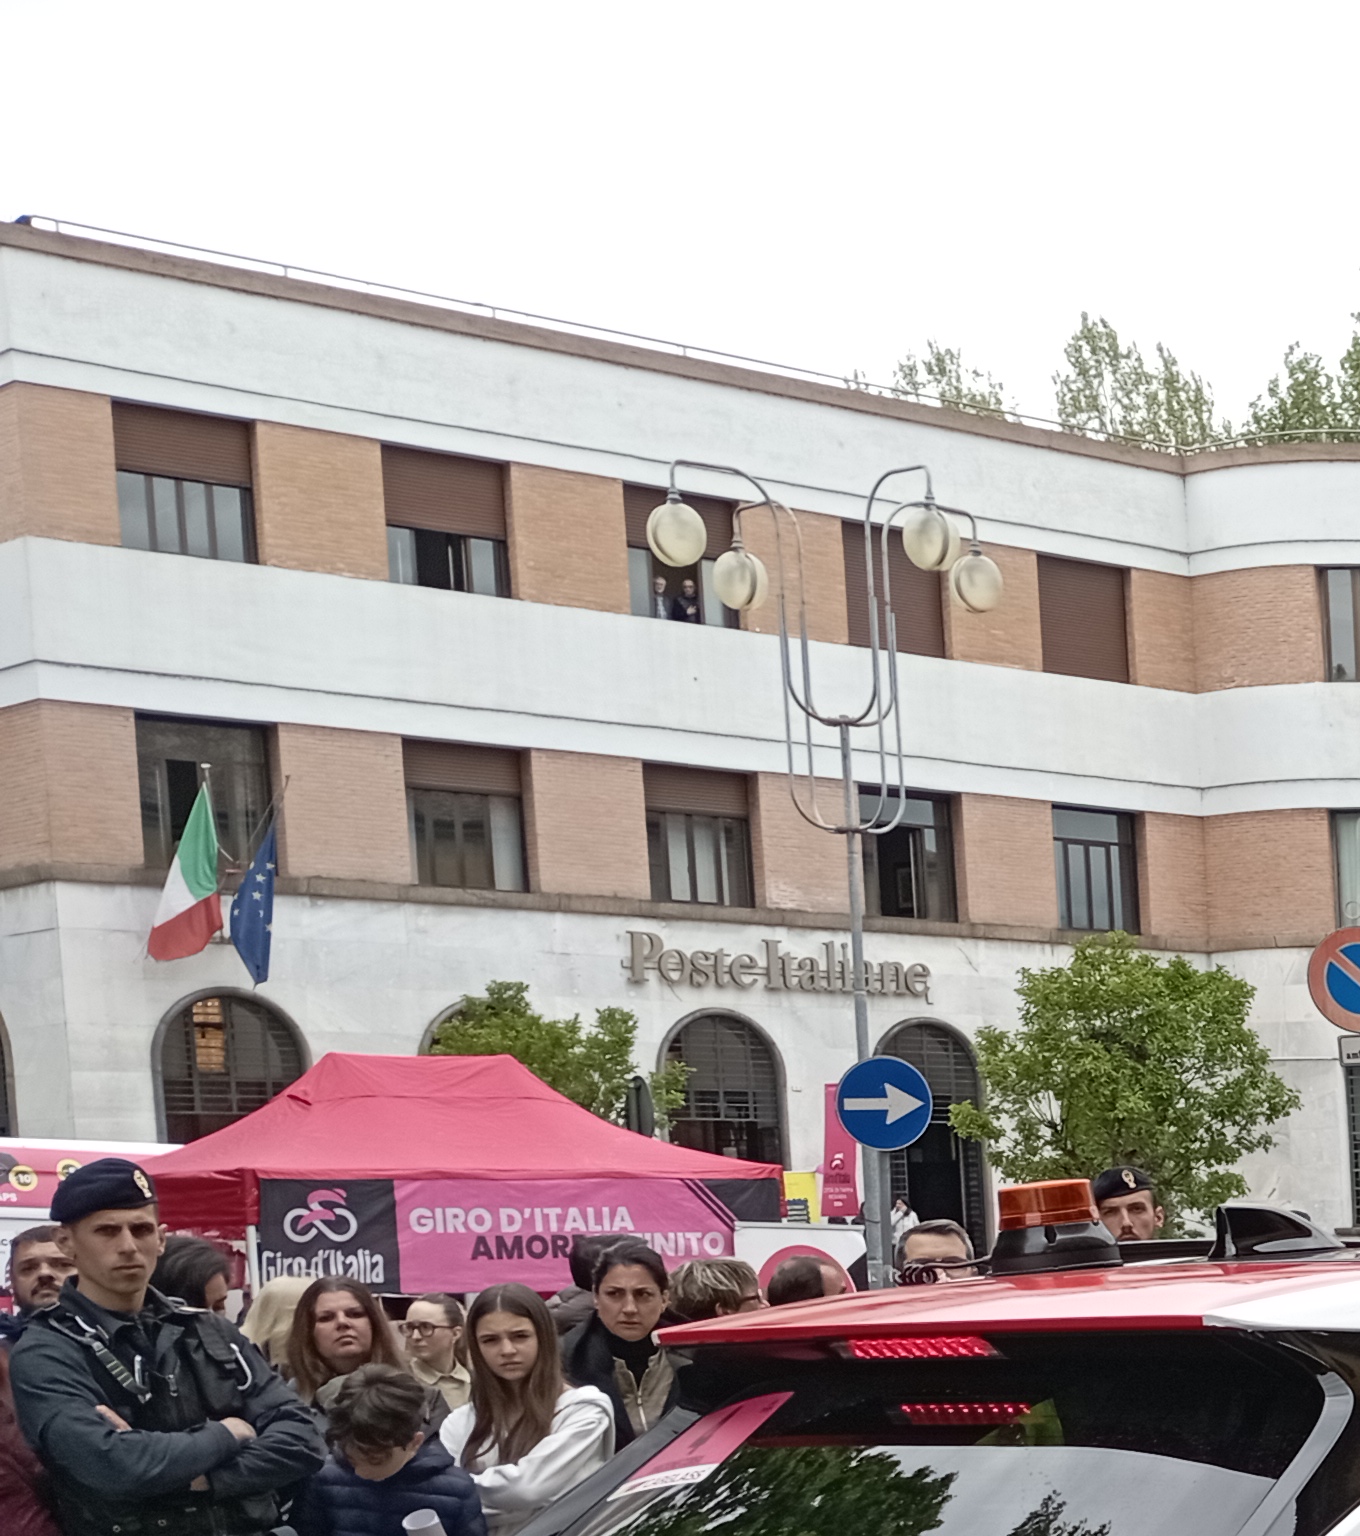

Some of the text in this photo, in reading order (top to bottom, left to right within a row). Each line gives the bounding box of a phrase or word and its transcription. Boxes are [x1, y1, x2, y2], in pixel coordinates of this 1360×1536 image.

[409, 1206, 635, 1234] GIRO D'ITALIA
[261, 1248, 385, 1284] Giro d'Italia
